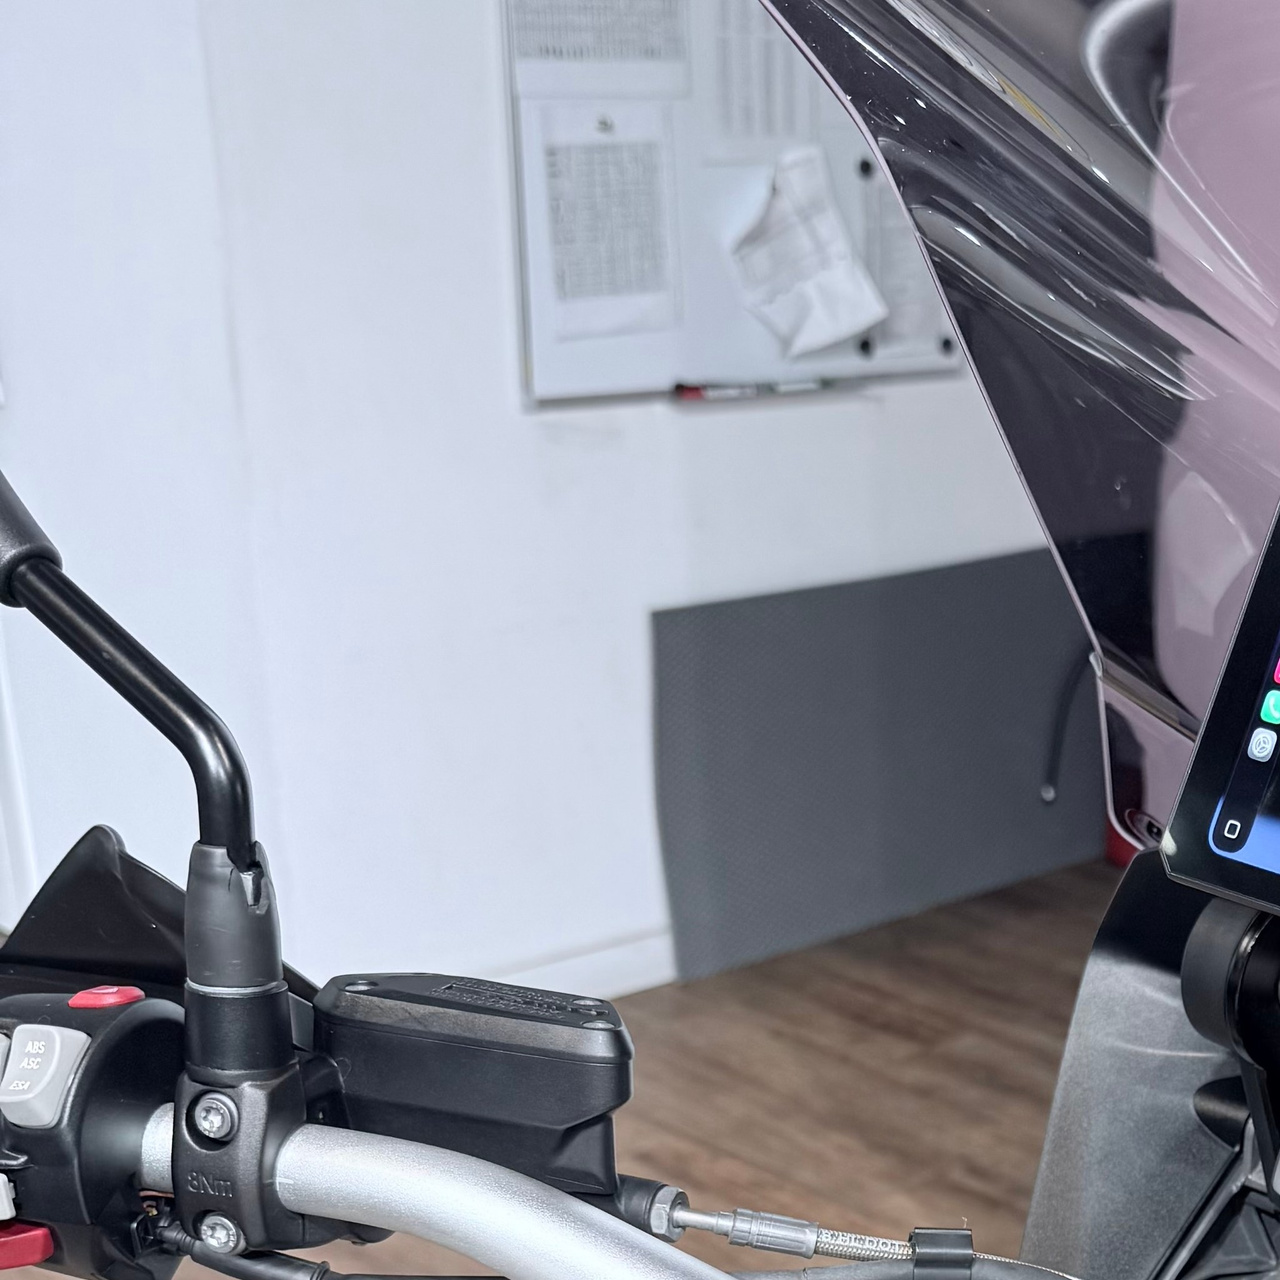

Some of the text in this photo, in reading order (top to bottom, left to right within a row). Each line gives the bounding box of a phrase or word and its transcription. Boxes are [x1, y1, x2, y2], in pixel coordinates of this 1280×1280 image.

[25, 1040, 46, 1054] ABS
[19, 1057, 42, 1069] ASC
[9, 1080, 31, 1090] ESA
